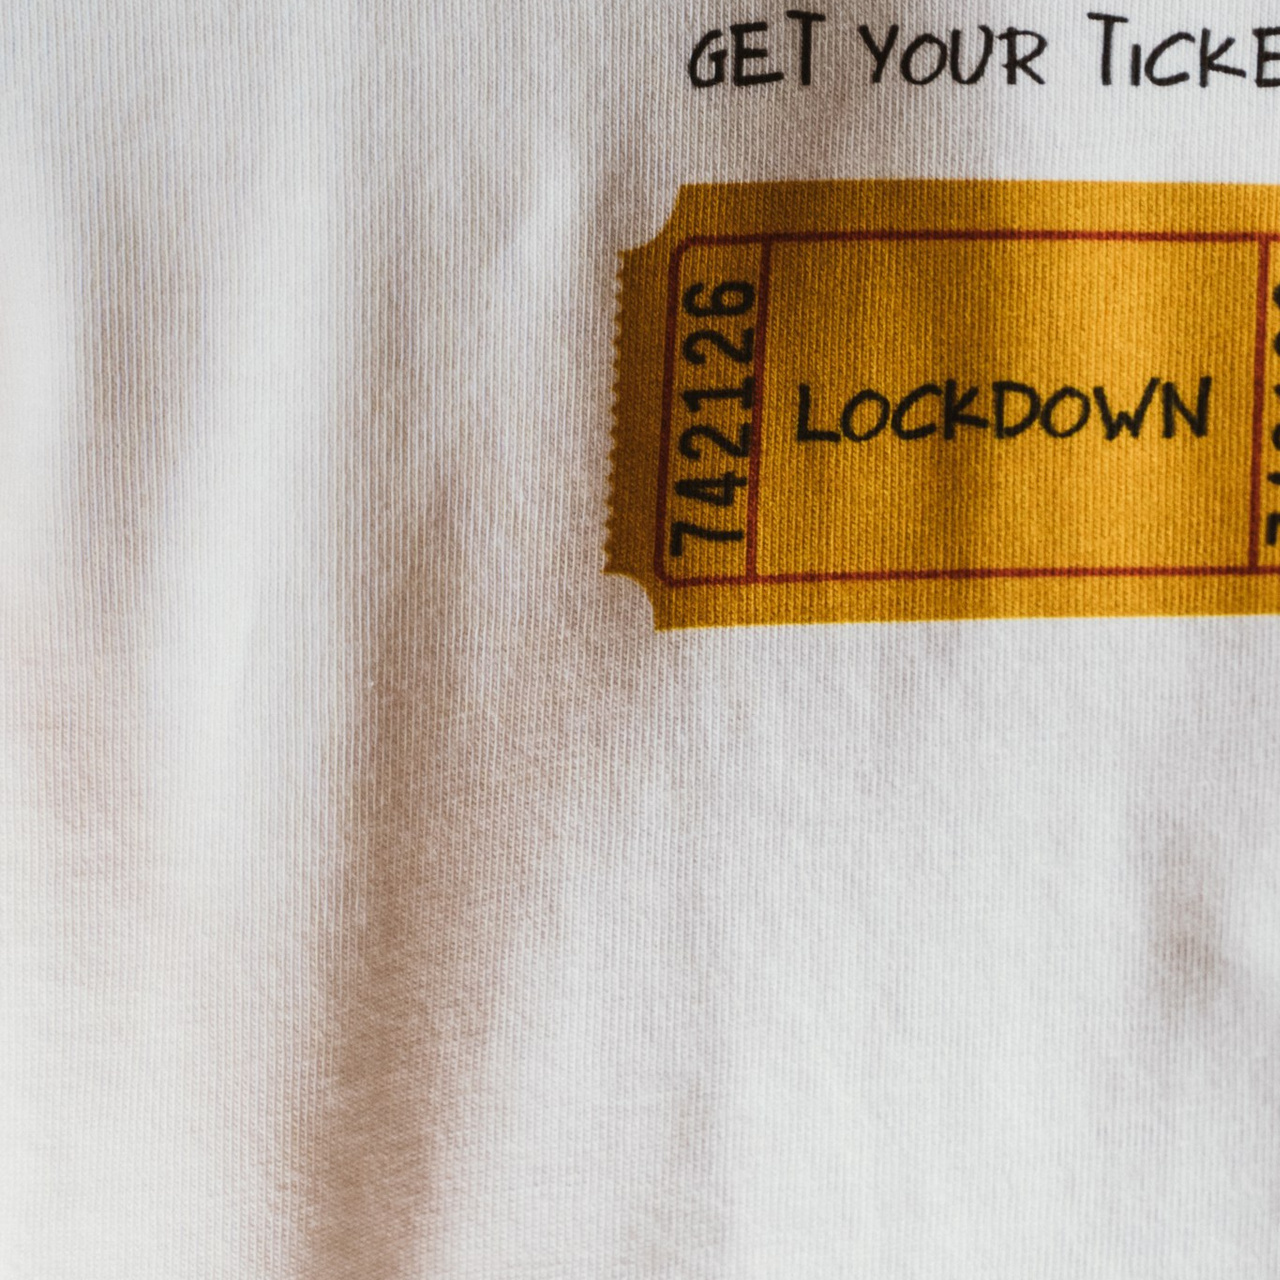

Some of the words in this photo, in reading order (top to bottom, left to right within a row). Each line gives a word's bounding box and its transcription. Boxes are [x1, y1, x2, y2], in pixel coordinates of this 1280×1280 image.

[687, 10, 826, 89] GET
[858, 23, 1049, 87] YOUR
[669, 278, 756, 558] 742126
[796, 375, 1213, 443] LOCKDOWN
